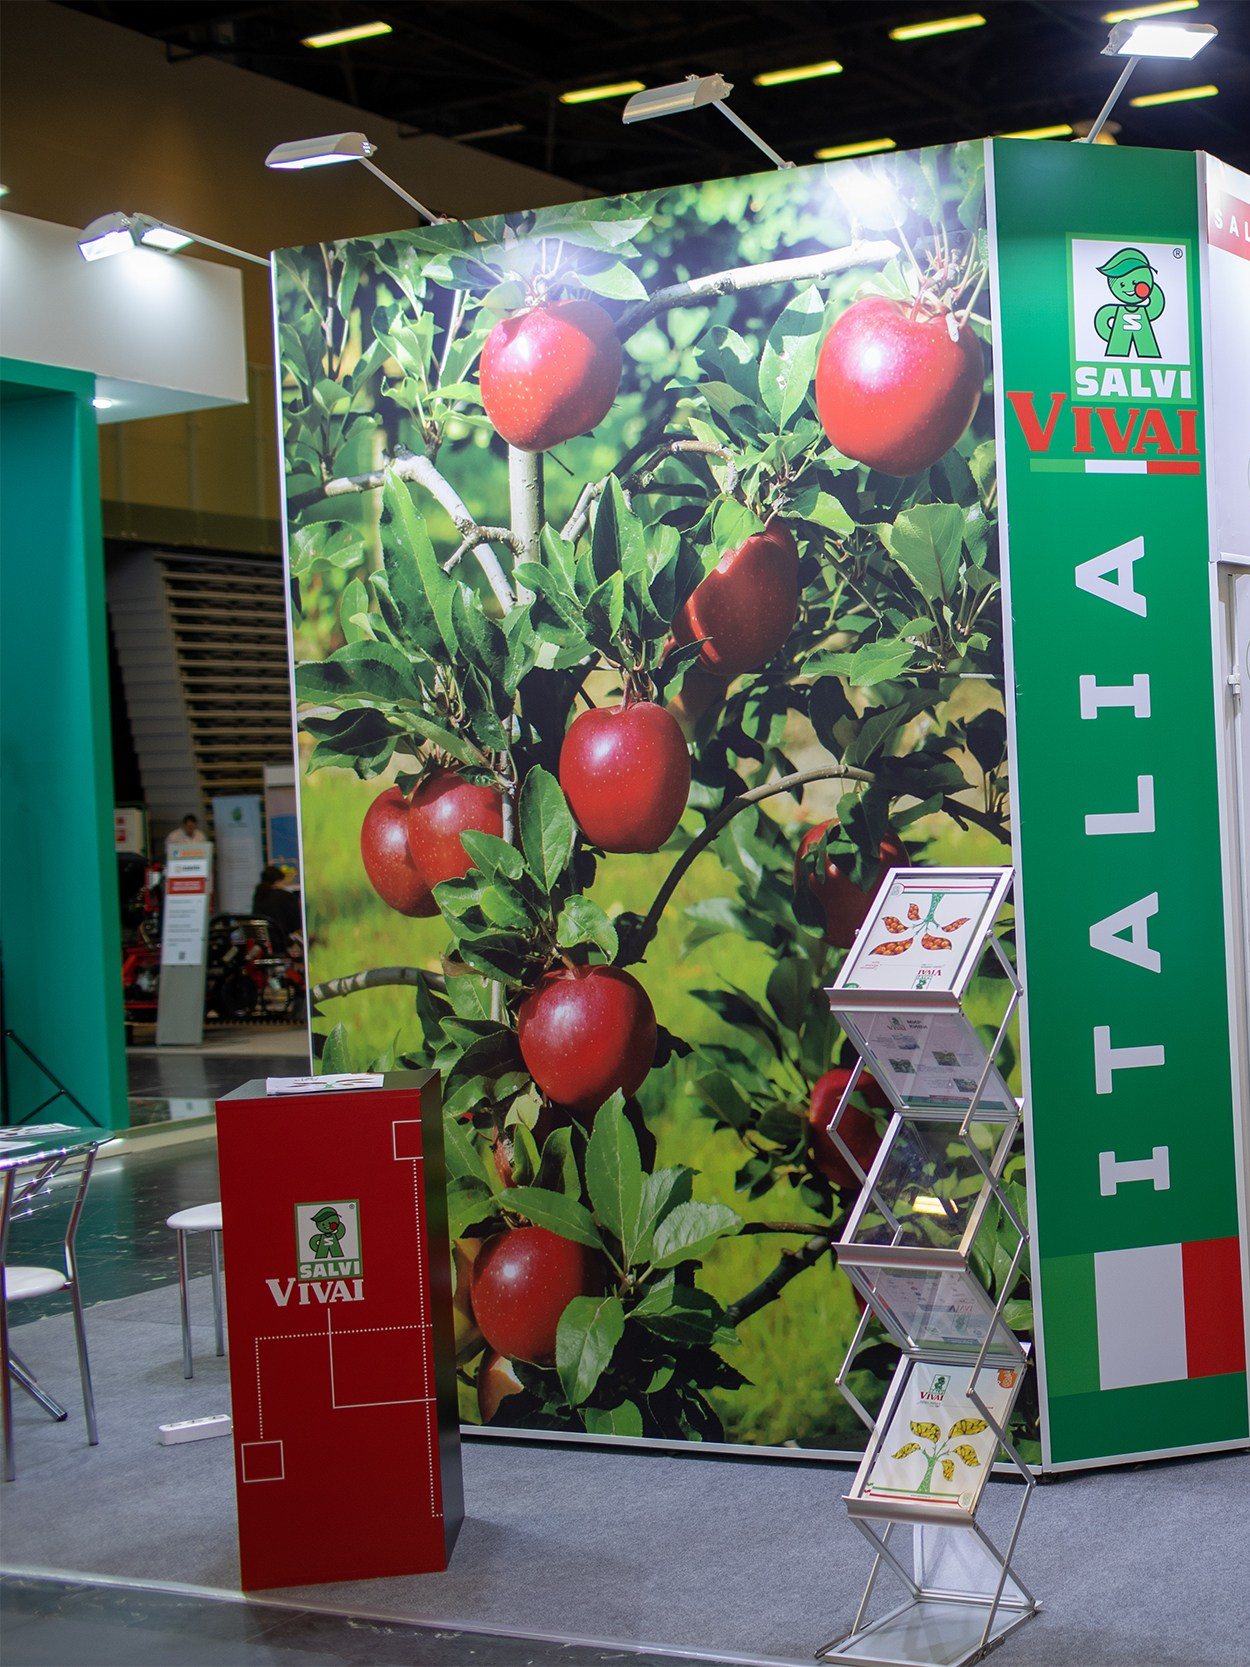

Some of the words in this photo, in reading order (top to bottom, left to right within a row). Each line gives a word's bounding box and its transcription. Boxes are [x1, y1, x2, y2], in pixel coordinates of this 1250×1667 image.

[1075, 366, 1192, 399] SALVI
[1006, 391, 1200, 455] VIVAI
[1074, 535, 1170, 1197] ITALIA
[300, 1261, 361, 1279] SALVI
[265, 1277, 365, 1307] VIVAI
[920, 1391, 944, 1401] VIVAI
